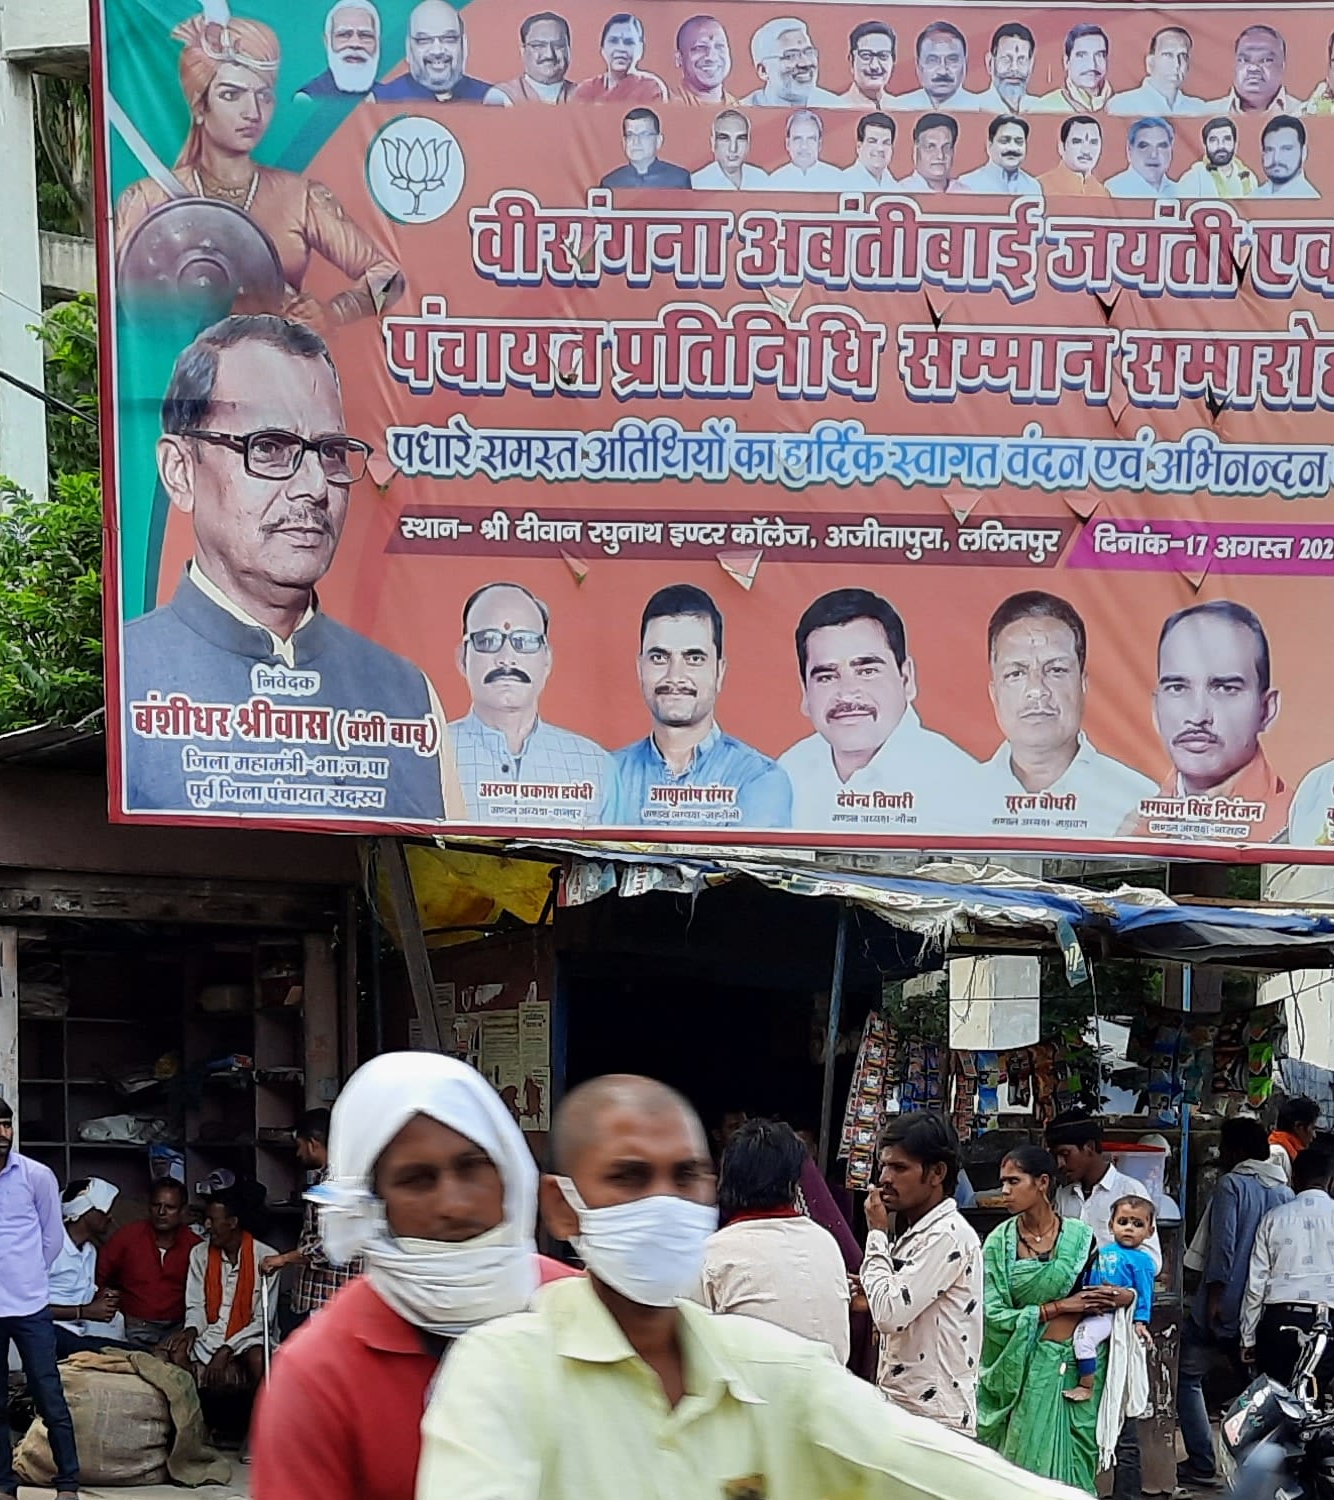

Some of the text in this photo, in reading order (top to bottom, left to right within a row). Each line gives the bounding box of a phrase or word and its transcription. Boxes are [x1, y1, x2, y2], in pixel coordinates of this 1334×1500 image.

[473, 192, 731, 280] वीरांगना
[739, 197, 1041, 291] अबंतीबाई
[1049, 203, 1245, 290] जयंती
[386, 300, 605, 389] पंचायत
[611, 308, 883, 391] प्रतिनिधि
[901, 328, 1116, 396] सम्मान
[475, 434, 579, 475] समस्त
[585, 418, 732, 474] अतिथियों
[733, 435, 775, 475] का
[781, 423, 886, 482] हार्दिक
[889, 440, 1000, 479] स्वागत
[1006, 428, 1086, 481] वंदन
[1093, 431, 1152, 483] एवं
[1152, 435, 1328, 490] अभिनन्दन
[400, 511, 1061, 563] स्थान- श्री दीवान रघुनाथ इण्टर कॉलेज, अजीतापुरा, ललितपुर
[1093, 522, 1209, 557] दिनांक-17
[1213, 535, 1295, 560] अगस्त
[131, 693, 232, 737] बंशीधर
[235, 698, 331, 742] श्रीवास
[185, 750, 230, 770] जिला
[189, 778, 384, 807] पूर्व जिला पंचायत सदस्य
[520, 784, 559, 800] प्रकाश
